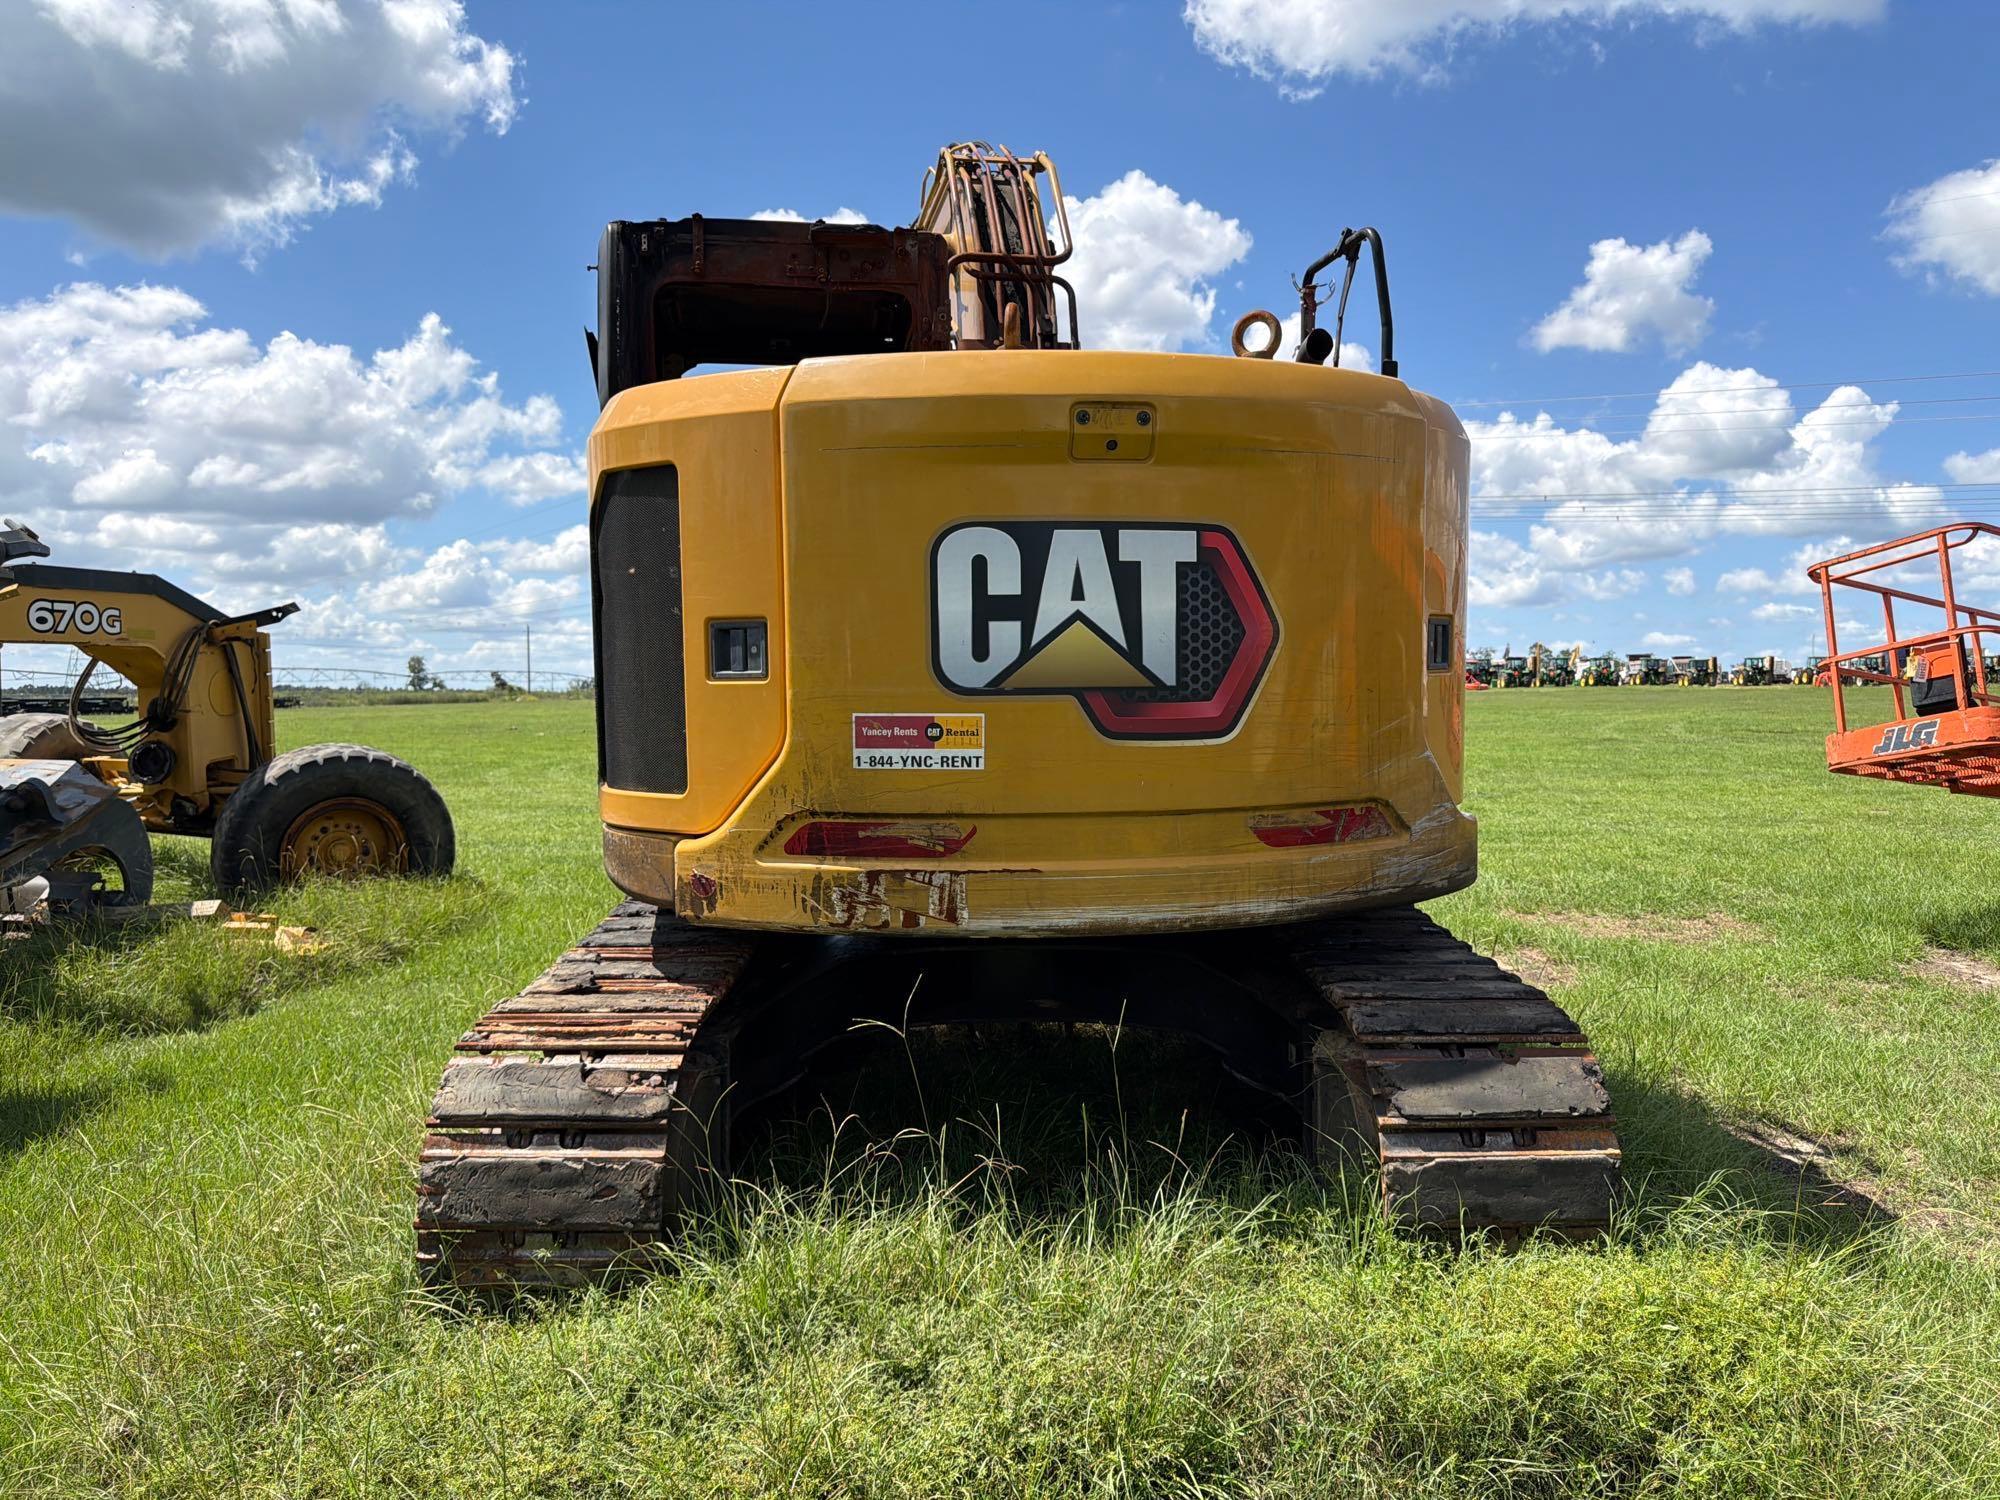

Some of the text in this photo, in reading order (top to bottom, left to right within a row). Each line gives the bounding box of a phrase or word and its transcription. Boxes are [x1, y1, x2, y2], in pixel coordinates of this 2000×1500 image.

[27, 599, 122, 635] 670G
[937, 526, 1197, 688] CAT
[862, 727, 918, 737] Yancey Rents
[927, 728, 979, 736] CAT Rental
[1873, 719, 1940, 755] JLG
[855, 755, 982, 768] 1-844-YNC-RENT
